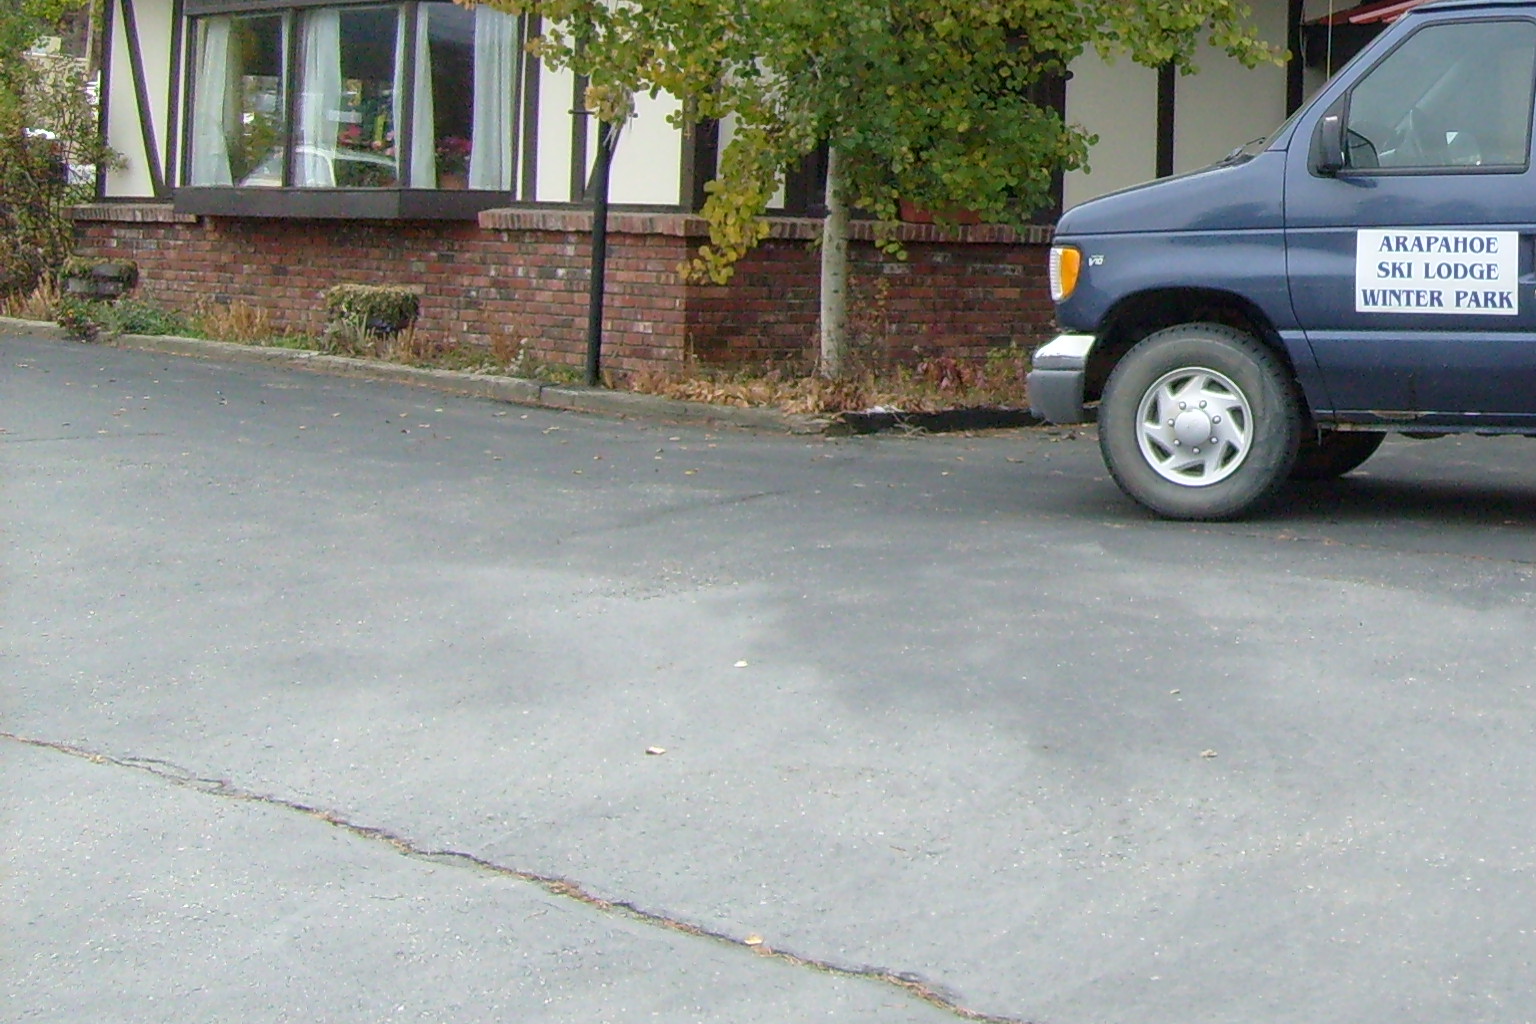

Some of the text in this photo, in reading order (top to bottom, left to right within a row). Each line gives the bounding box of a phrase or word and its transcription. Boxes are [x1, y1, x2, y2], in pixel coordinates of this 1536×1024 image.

[1378, 235, 1499, 254] ARAPAHOE
[1377, 261, 1499, 280] SKI LODGE
[1361, 288, 1514, 309] WINTER PARK
